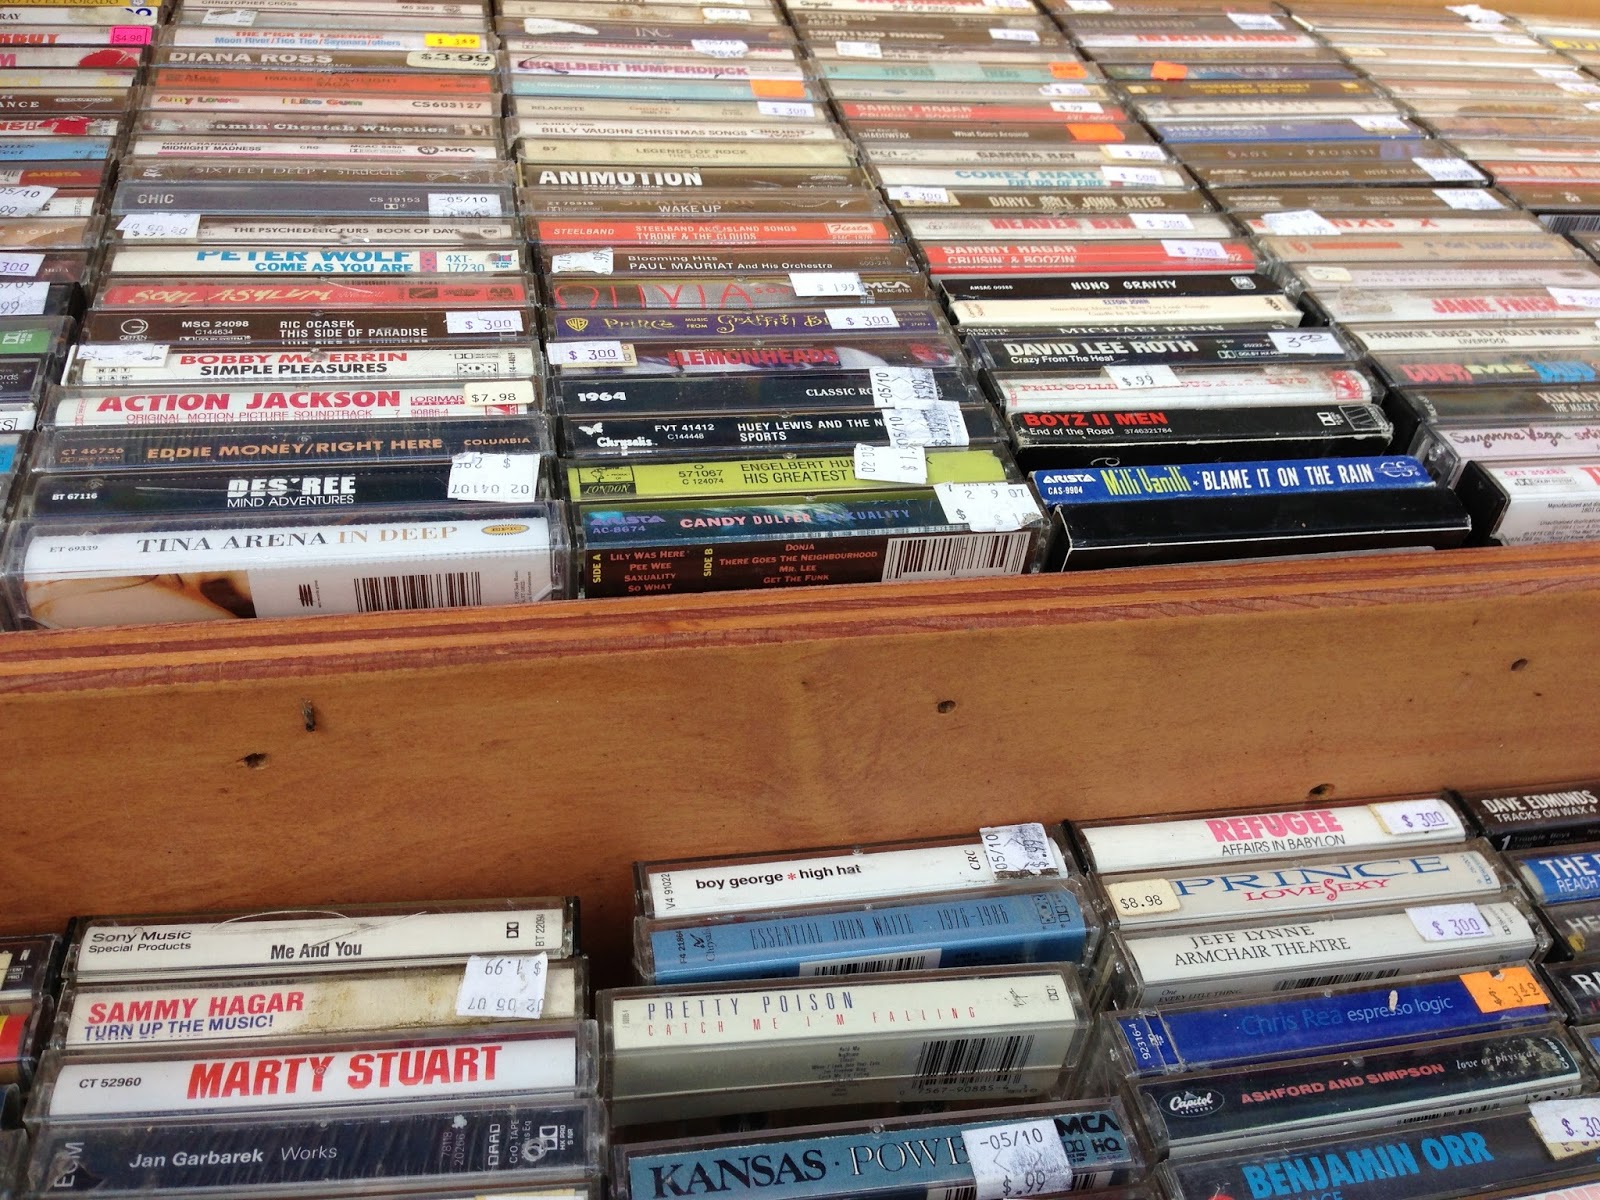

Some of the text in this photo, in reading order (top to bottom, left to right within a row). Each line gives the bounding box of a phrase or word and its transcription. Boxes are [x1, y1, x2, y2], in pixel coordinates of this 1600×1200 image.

[169, 52, 333, 63] DIANA ROSS
[362, 124, 448, 133] Wheelies
[636, 128, 705, 136] CHRISTMAS
[539, 170, 703, 186] ANIMOTION
[137, 193, 174, 204] CHIC
[658, 205, 722, 213] WAKE UP
[553, 228, 615, 236] STEELBAND
[942, 245, 1077, 254] SAMMY HAGAR
[628, 255, 688, 263] Blooming
[629, 262, 666, 270] PAUL
[670, 262, 733, 270] MAURIAT
[782, 261, 833, 269] Orchestra
[255, 262, 413, 272] COME AS YOU ARE
[1070, 279, 1178, 291] NUNO GRAVITY
[181, 320, 249, 328] MSG 24098
[280, 320, 355, 330] RIC OCASEK
[279, 328, 428, 338] THIS SIDE OF PARADISE
[1366, 326, 1581, 340] FRANKIE GOES TO HOLLYWOOD
[1003, 339, 1200, 357] DAVID LEE ROTH
[1458, 337, 1509, 346] LIVERPOOL
[1010, 353, 1115, 365] Crazy From The Heat
[200, 363, 388, 376] SIMPLE PLEASURES
[471, 393, 517, 402] $7.98
[577, 391, 627, 402] 1964
[805, 387, 857, 398] CLASSIC
[97, 390, 400, 412] ACTION JACKSON
[1551, 402, 1593, 413] THE MAXX
[737, 418, 871, 432] HUEY LEWIS AND THE
[1023, 412, 1169, 427] BOYZ II MEN
[654, 423, 715, 433] FVT 41412
[1030, 426, 1115, 436] End of the Road
[463, 437, 531, 447] COLUMBIA
[739, 431, 787, 443] SPORTS
[1042, 473, 1097, 484] ARISTA
[1202, 463, 1375, 491] BLAME IT ON THE RAIN
[227, 494, 355, 508] MIND ADVENTURES
[137, 526, 458, 553] TINA ARENA IN DEEP
[592, 553, 602, 583] SIDE A
[703, 547, 713, 577] SIDE B
[1480, 789, 1599, 814] DAVE EDMUNDS
[1493, 805, 1598, 823] TRACKS ON WAX 4
[1205, 809, 1344, 843] REFUGEE
[1221, 833, 1346, 857] AFFAIRS IN BABYLON
[1538, 855, 1597, 880] THE
[695, 864, 863, 890] boy george high hat
[1175, 855, 1450, 898] PRINCE
[1119, 894, 1163, 911] $8.98
[91, 929, 192, 944] Sony Music
[1188, 924, 1315, 949] JEFF LYNNE
[88, 941, 192, 954] Special Products
[270, 941, 363, 960] Me And You
[1174, 936, 1351, 967] ARMCHAIR THEATRE
[88, 991, 305, 1025] SAMMY HAGAR
[647, 990, 854, 1021] PRETTY POISON
[1241, 995, 1455, 1036] Chris Rea espresso logic
[84, 1015, 274, 1041] TURN UP THE MUSIC!
[186, 1045, 503, 1100] MARTY STUART
[78, 1076, 142, 1089] CT 52960
[1240, 1063, 1446, 1104] ASHFORD AND SIMPSON
[129, 1144, 338, 1168] Jan Garbarek Works
[1241, 1130, 1495, 1200] BENJAMIN ORR
[648, 1149, 828, 1200] KANSAS
[1002, 1170, 1046, 1197] $.99
